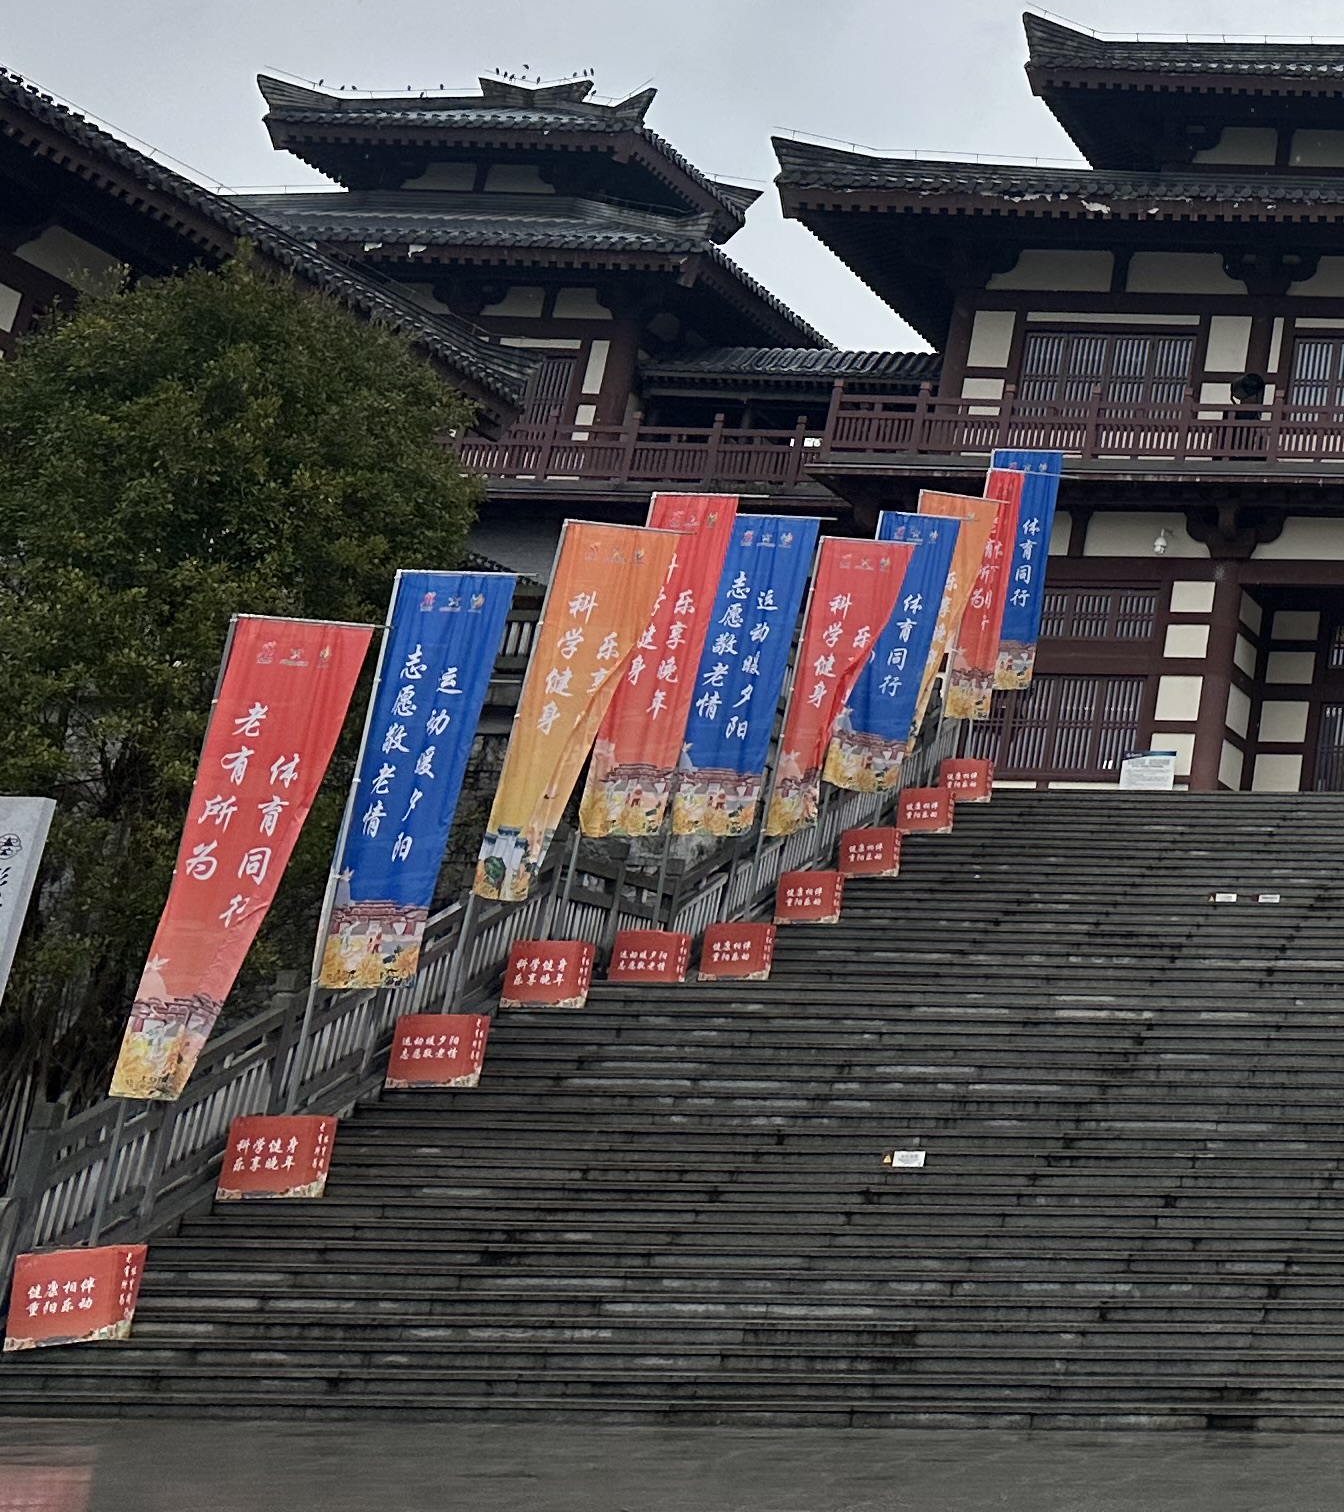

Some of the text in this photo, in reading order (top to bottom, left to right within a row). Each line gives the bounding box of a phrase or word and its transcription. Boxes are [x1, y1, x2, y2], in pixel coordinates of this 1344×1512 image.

[1010, 517, 1041, 608] 体育同行
[536, 590, 599, 736] 科学健身
[646, 588, 696, 720] 乐享晚年
[695, 570, 751, 720] 志愿敬老情
[726, 588, 778, 740] 运动暖夕阳
[808, 592, 853, 709] 科学健身
[878, 593, 923, 697] 体育同行
[184, 700, 269, 883] 老有所为
[362, 643, 428, 839] 志愿敬老情
[391, 665, 463, 862] 运动暖夕阳
[513, 972, 566, 987] 乐享晚年
[515, 956, 568, 973] 科学健身
[232, 1155, 295, 1172] 乐享晚年
[236, 1135, 298, 1155] 科学健身
[25, 1296, 93, 1317] 重阳乐动
[27, 1275, 96, 1300] 健康相伴
